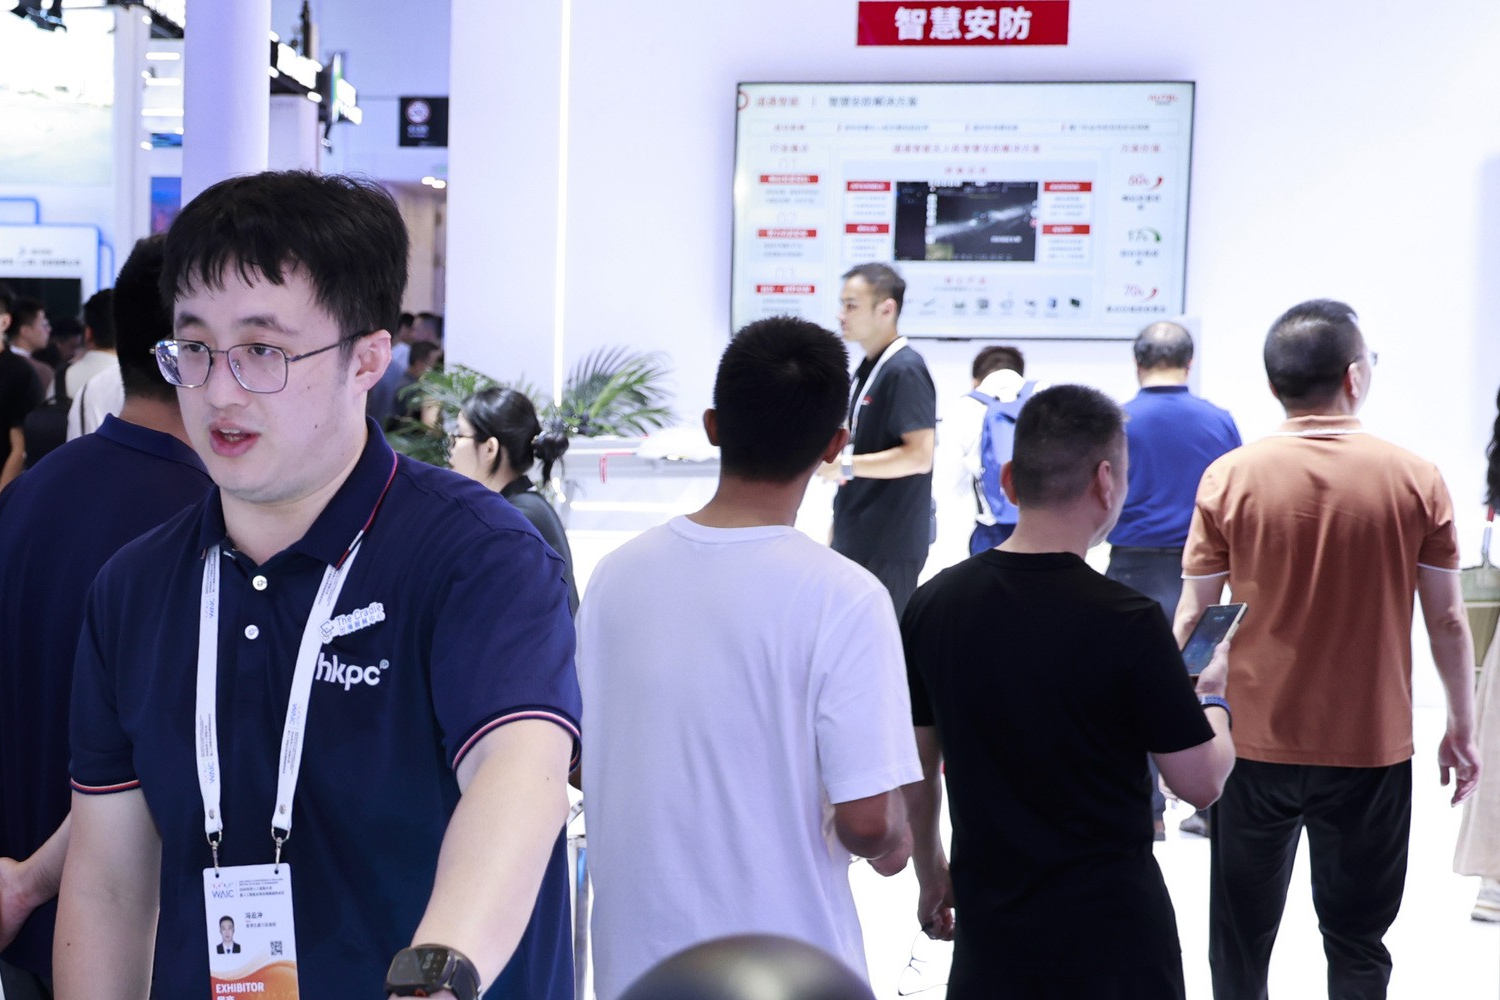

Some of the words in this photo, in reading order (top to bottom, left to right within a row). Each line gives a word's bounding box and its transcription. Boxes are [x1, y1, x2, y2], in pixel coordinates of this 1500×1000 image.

[895, 6, 1032, 40] 智慧安防
[338, 613, 353, 627] The
[354, 602, 383, 620] Cradle
[211, 889, 234, 899] WAIC
[216, 981, 265, 994] EXHIBITOR
